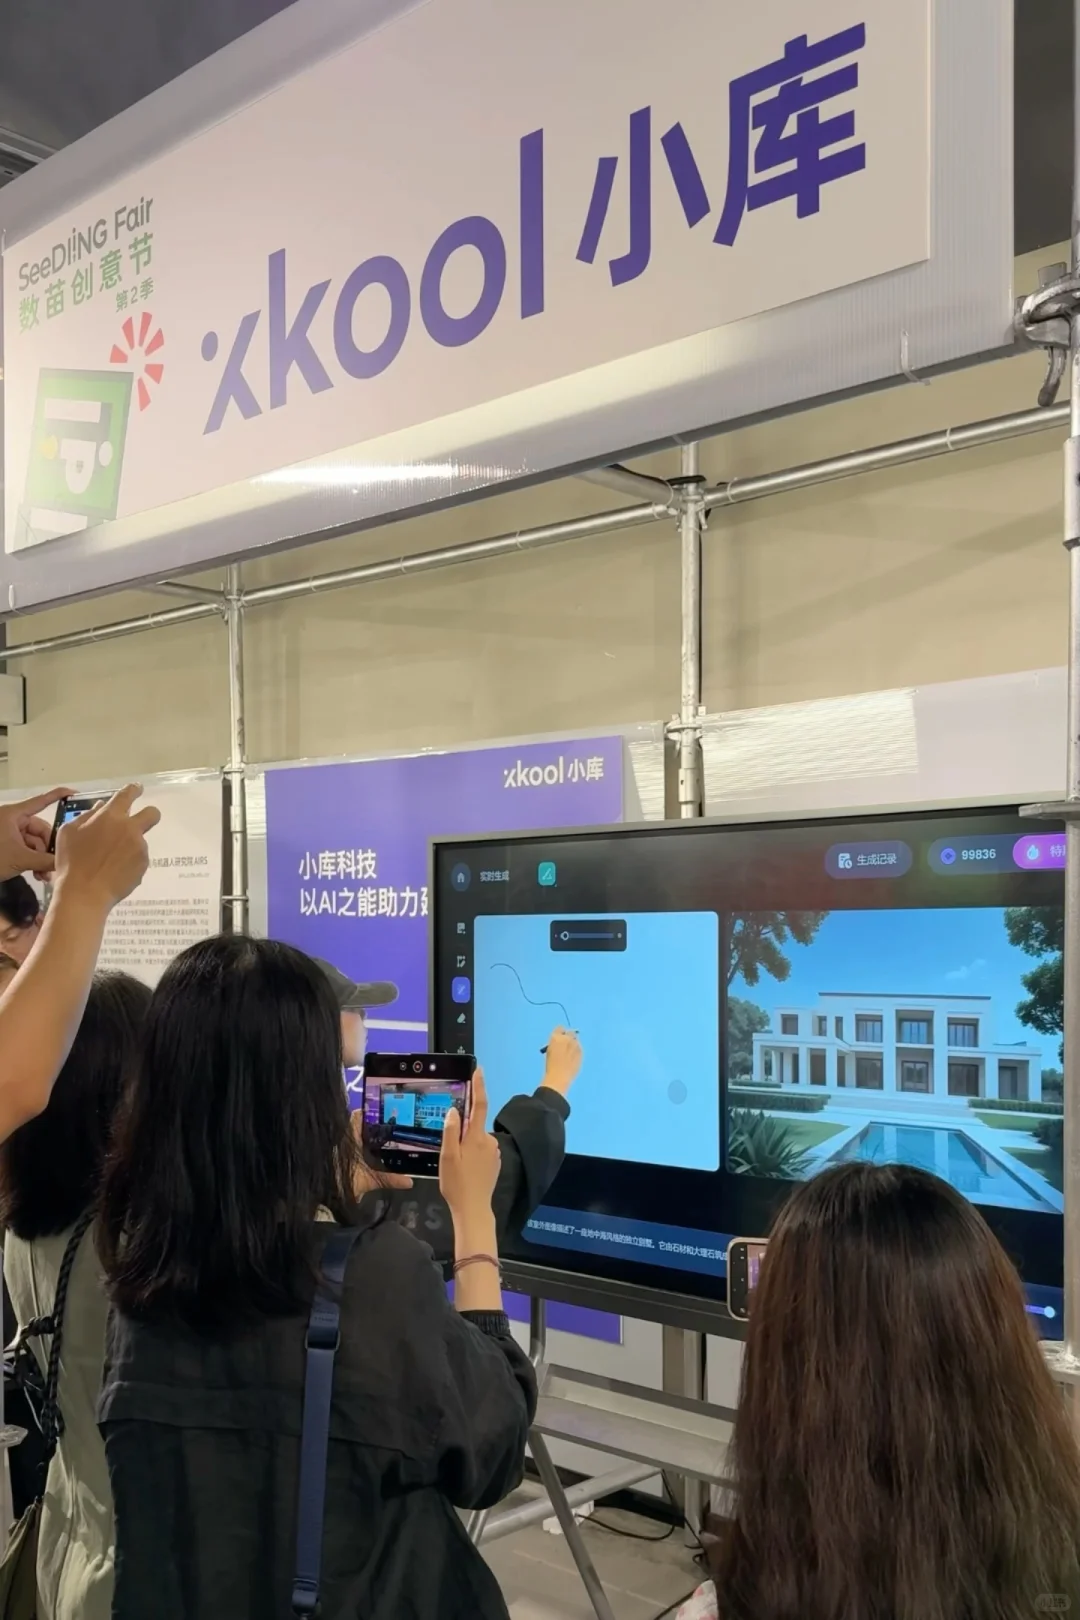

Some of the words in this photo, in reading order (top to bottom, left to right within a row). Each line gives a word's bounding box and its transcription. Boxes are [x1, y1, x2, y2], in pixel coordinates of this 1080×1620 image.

[114, 196, 153, 240] Fair
[201, 127, 545, 435] xkool
[575, 22, 866, 287] 小库
[18, 231, 154, 334] 数苗创意节
[115, 276, 154, 313] 第2季
[503, 755, 564, 788] xkool
[568, 756, 604, 782] 小库
[298, 848, 378, 880] 小库科技
[856, 852, 897, 866] 生成记录
[961, 848, 996, 860] 99836
[480, 869, 510, 882] 实时生成
